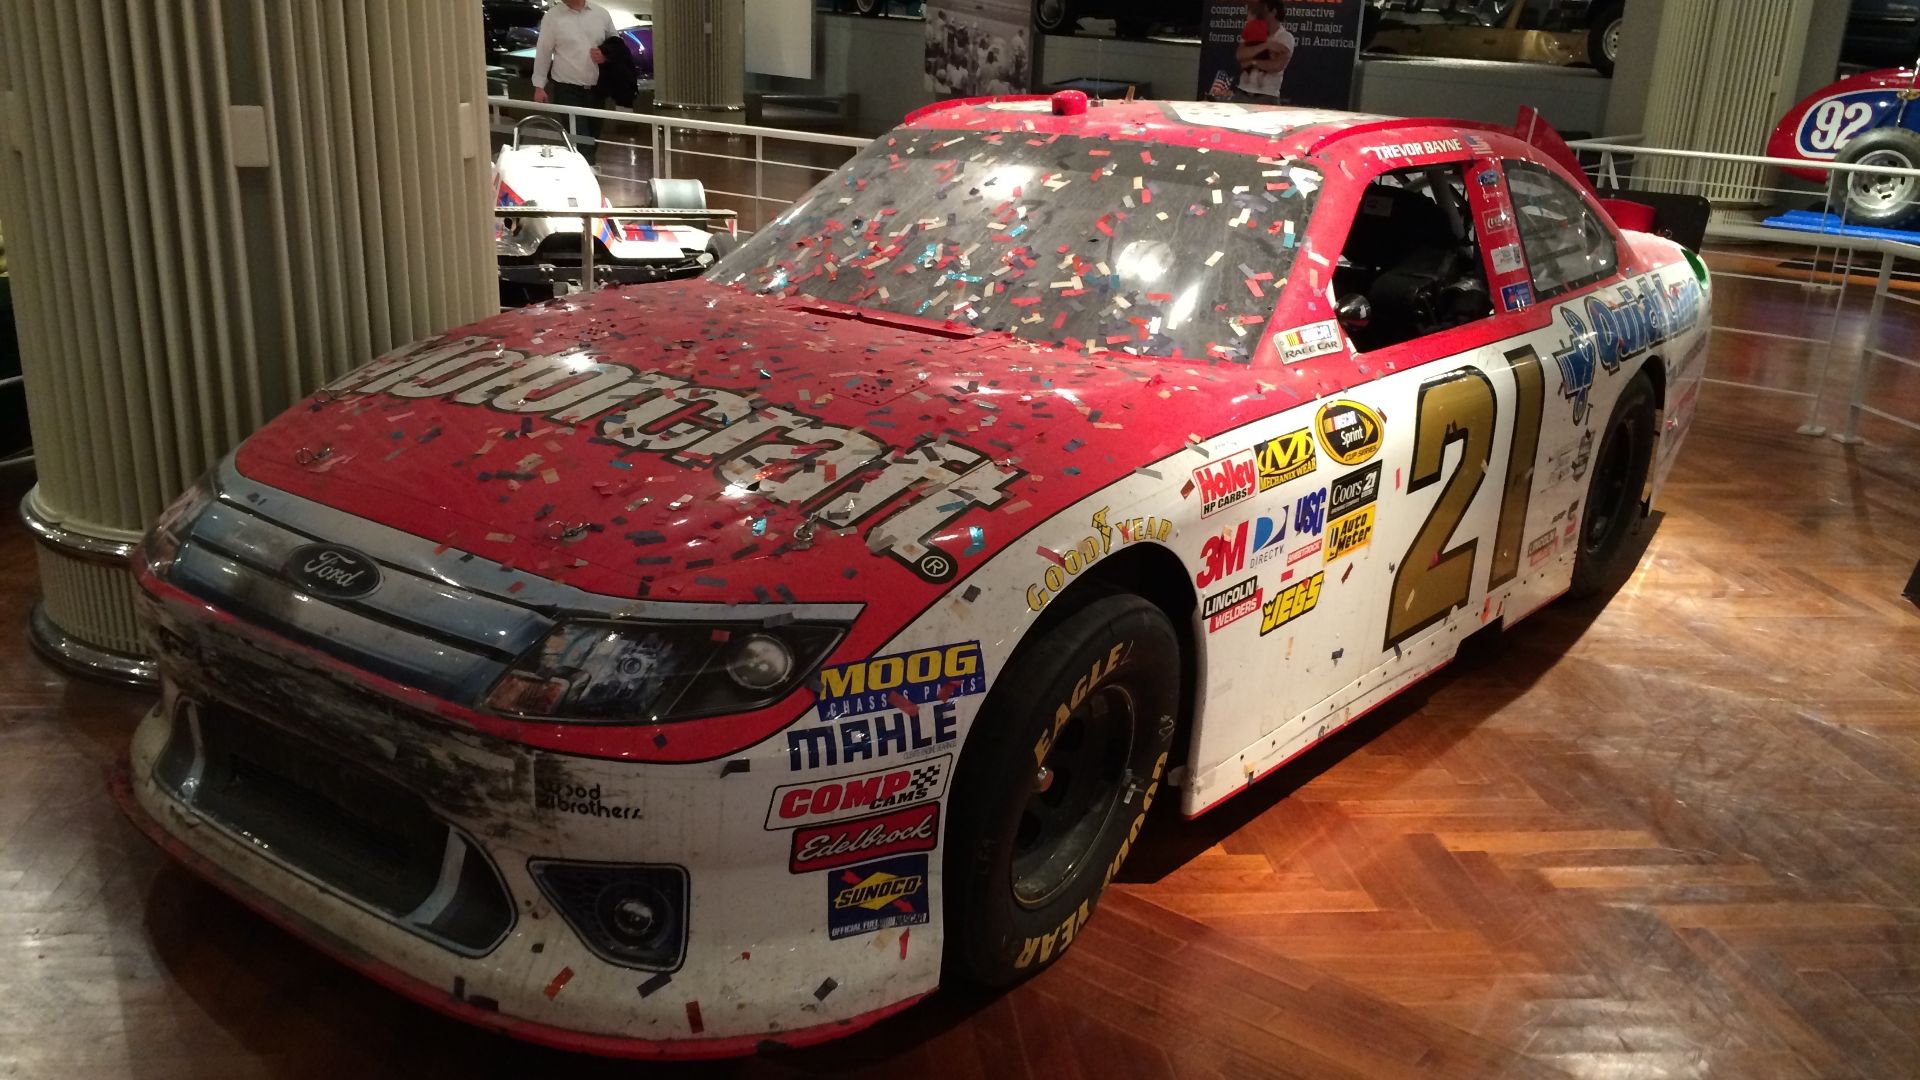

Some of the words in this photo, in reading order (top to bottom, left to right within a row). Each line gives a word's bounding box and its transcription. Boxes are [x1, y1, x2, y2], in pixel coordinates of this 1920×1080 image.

[1286, 6, 1335, 18] nteractive
[1301, 20, 1312, 31] all
[1314, 23, 1343, 34] major
[1209, 32, 1234, 42] forms
[1301, 36, 1311, 46] in
[1811, 101, 1872, 150] 92
[1374, 142, 1423, 160] TREVOR
[1423, 138, 1463, 154] BAYNE
[1317, 341, 1338, 351] CAR
[1340, 425, 1364, 448] Sprint
[1194, 458, 1256, 505] Holley
[1260, 471, 1297, 490] MECHANIX
[1296, 456, 1316, 479] WEAR
[1332, 480, 1363, 506] Coors
[1363, 470, 1378, 491] 21
[1203, 502, 1216, 516] HP
[1216, 490, 1248, 510] CARBS
[1294, 487, 1327, 536] USG
[1382, 343, 1546, 653] 21
[304, 550, 366, 589] Ford
[1196, 520, 1250, 589] 3M
[1250, 544, 1284, 569] DIRECTV
[1204, 578, 1256, 617] LINCOLN
[1214, 597, 1258, 629] WELDERS
[1261, 571, 1324, 636] JEGS
[819, 643, 978, 701] MOOG
[924, 677, 976, 700] PATS
[829, 689, 909, 718] CHASSS
[1034, 641, 1126, 767] EAGLE
[786, 704, 957, 771] MAHLE
[778, 770, 912, 819] COMP
[868, 787, 928, 811] CAMS
[796, 814, 933, 862] Edelbrock
[835, 877, 920, 909] SUNOCO
[831, 923, 861, 937] OFFICIAL
